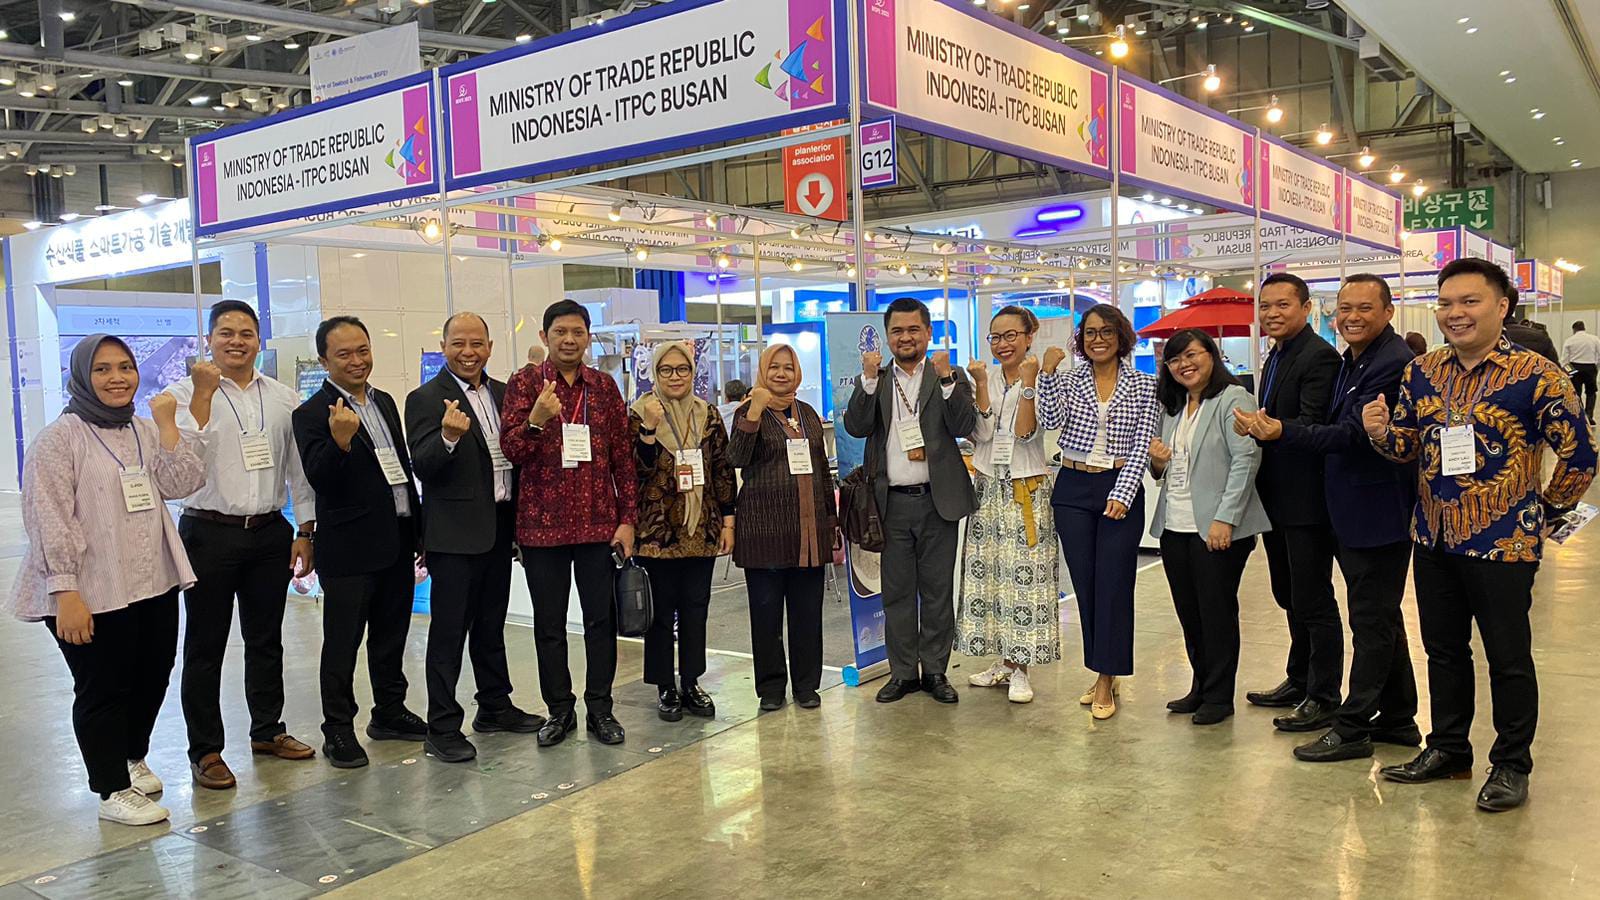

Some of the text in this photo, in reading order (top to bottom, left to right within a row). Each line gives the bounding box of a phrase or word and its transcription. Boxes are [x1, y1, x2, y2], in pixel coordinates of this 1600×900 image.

[489, 30, 755, 117] MINISTRY OF TRADE REPUBLIC
[907, 26, 1078, 110] MINISTRY OF TRADE REPUBLIC
[511, 104, 603, 144] INDONESIA
[615, 91, 656, 122] ITPC
[661, 74, 727, 113] BUSAN
[926, 70, 997, 115] INDONESIA
[1005, 96, 1031, 125] ITPC
[1032, 107, 1066, 136] BUSAN
[223, 123, 385, 179] MINISTRY OF TRADE REPUBLIC
[795, 143, 832, 156] planterior
[862, 148, 893, 170] G12
[1141, 114, 1236, 164] MINISTRY OF TRADE REPUBLIC
[237, 173, 295, 201] INDONESIA
[301, 167, 327, 188] ITPC
[330, 155, 369, 182] BUSAN
[792, 153, 835, 166] association
[1152, 144, 1190, 172] INDONESIA
[1193, 159, 1208, 179] ITPC
[1209, 165, 1229, 184] BUSAN
[1403, 193, 1464, 215] 비상구
[1411, 215, 1459, 231] EXIT
[45, 239, 86, 267] 수산식품
[89, 229, 145, 258] 스마트가공
[839, 377, 848, 386] PT
